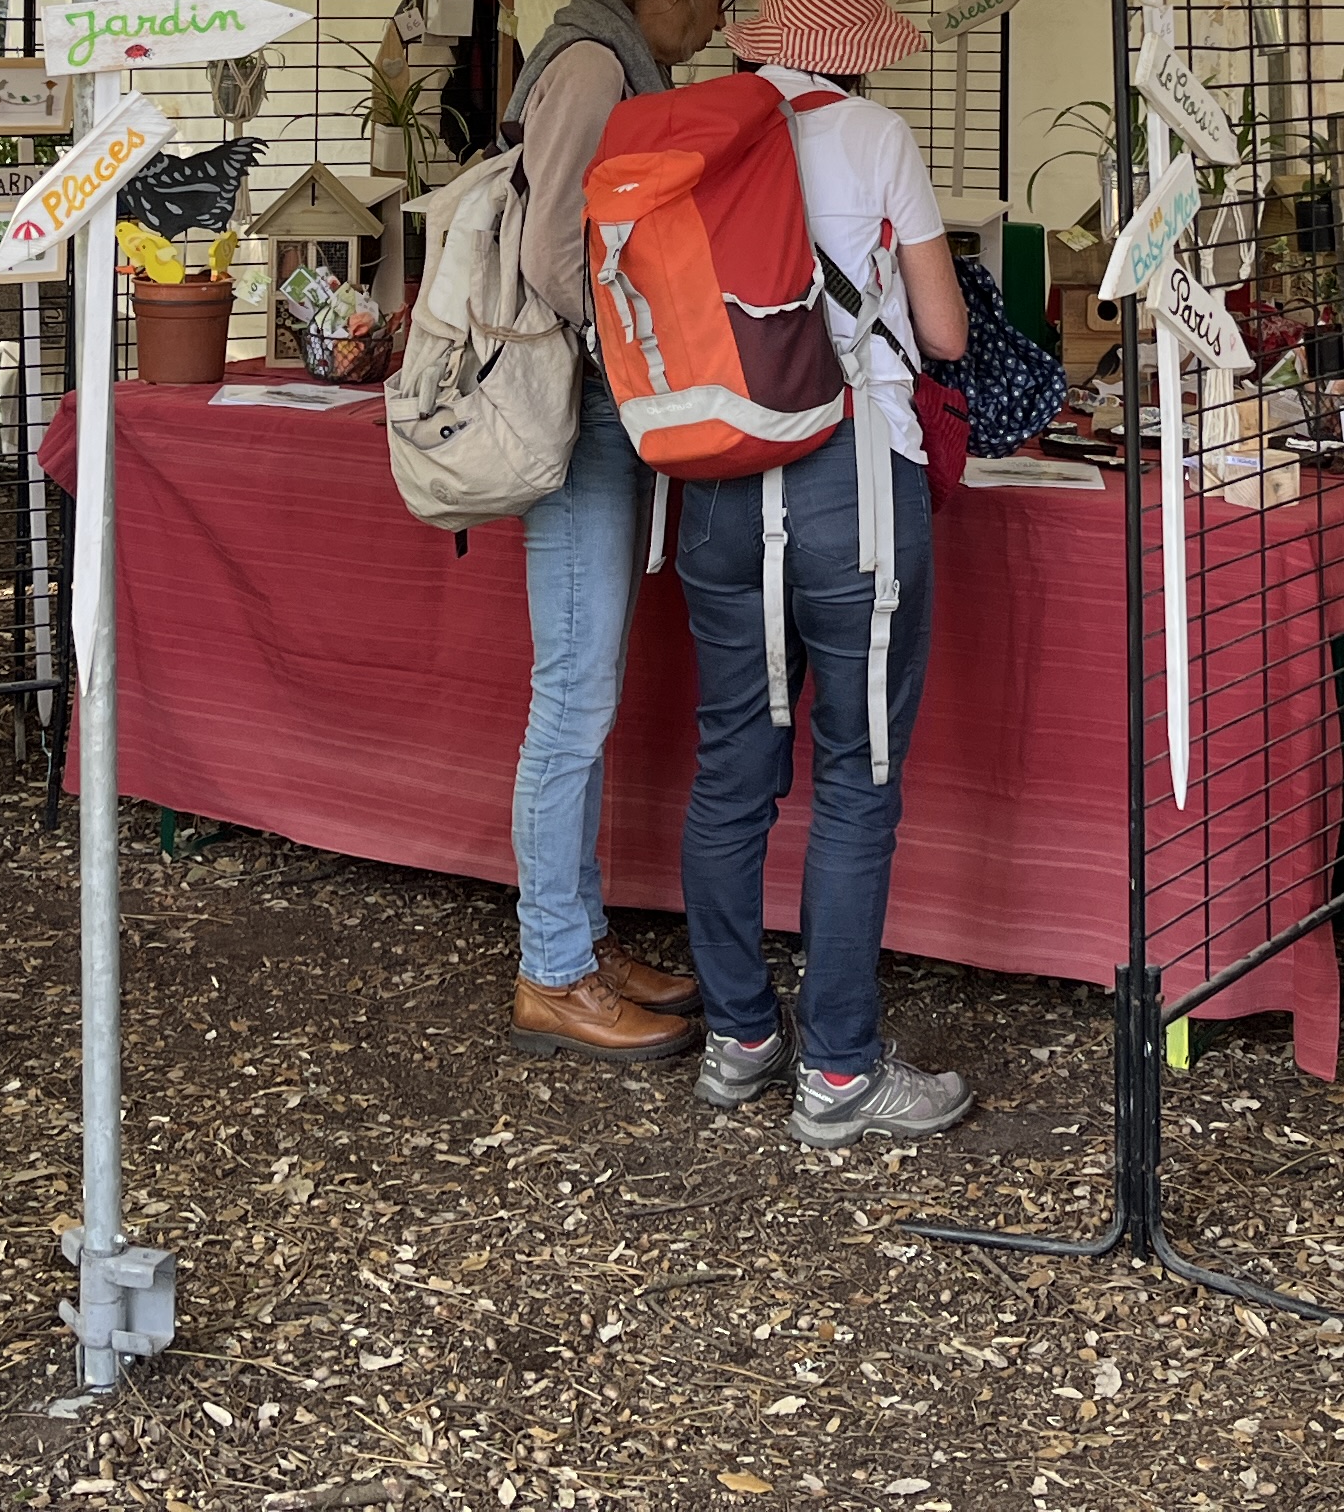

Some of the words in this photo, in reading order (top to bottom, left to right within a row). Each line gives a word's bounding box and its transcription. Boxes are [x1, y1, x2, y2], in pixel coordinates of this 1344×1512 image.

[64, 0, 247, 67] Jardin
[1156, 53, 1173, 92] Le
[1172, 67, 1221, 142] Croisic
[1167, 267, 1222, 357] Paris
